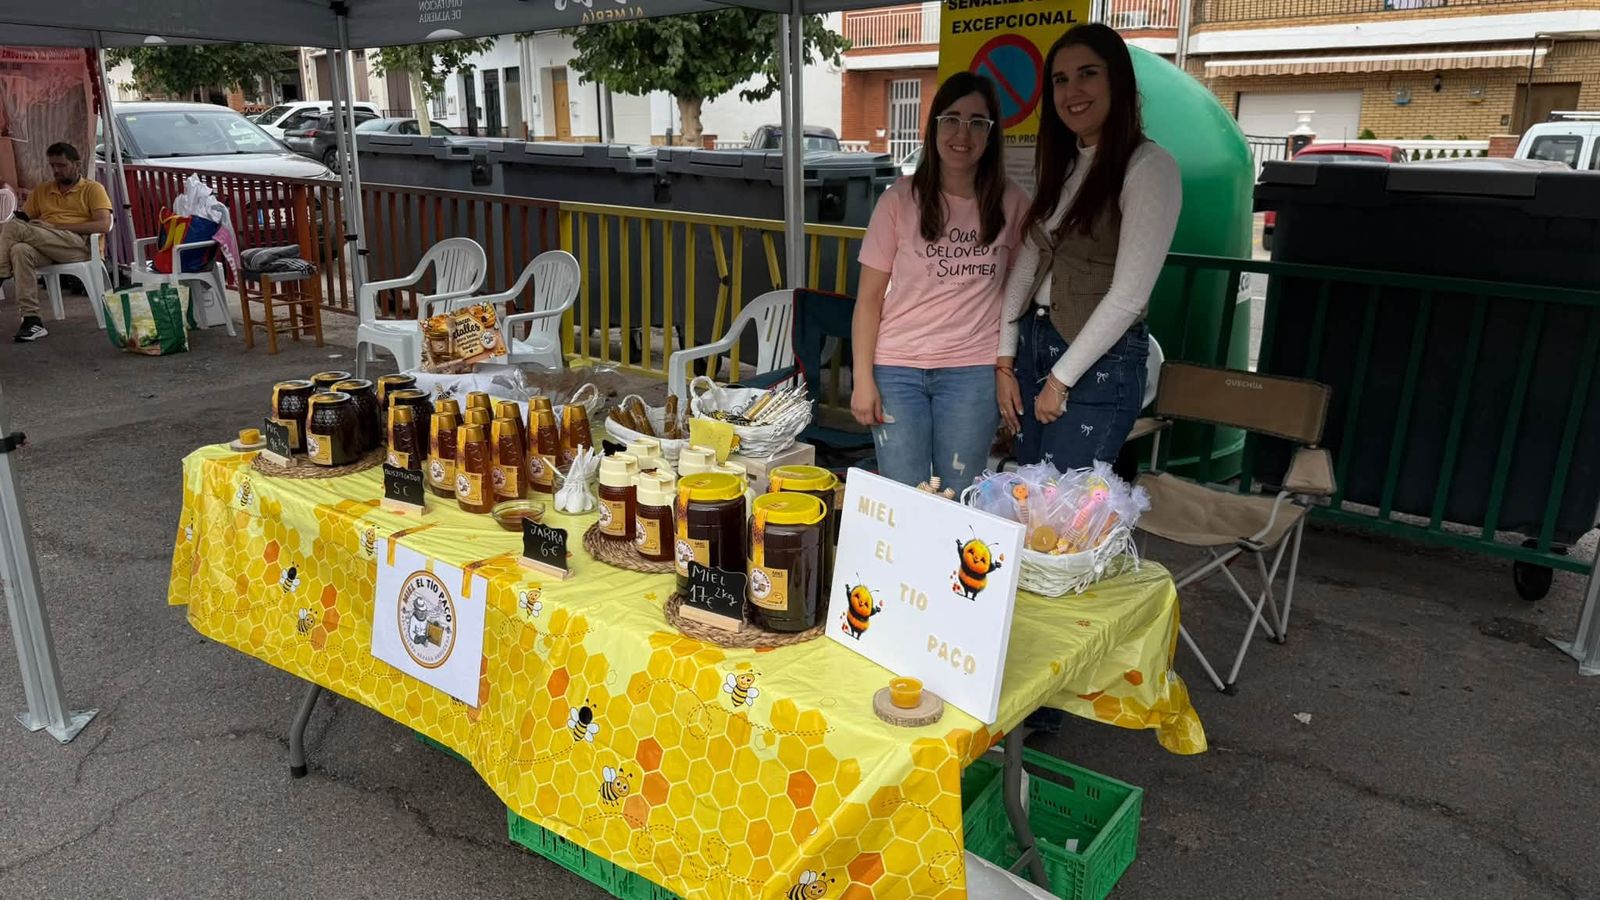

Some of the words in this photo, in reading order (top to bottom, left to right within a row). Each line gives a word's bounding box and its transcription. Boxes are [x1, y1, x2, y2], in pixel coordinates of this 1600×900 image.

[952, 10, 1077, 34] EXCEPCIONAL
[1018, 134, 1036, 144] PRO
[926, 244, 990, 258] BELOVED
[936, 259, 997, 278] SUMMER
[857, 495, 896, 528] MIEL
[530, 524, 564, 545] JARRA
[540, 542, 559, 558] 6€
[874, 540, 894, 564] EL
[691, 564, 726, 586] MIEL
[403, 583, 416, 604] MIEL
[416, 578, 424, 588] EL
[438, 592, 452, 622] PACO
[899, 582, 929, 612] TIO
[926, 634, 977, 676] PACO
